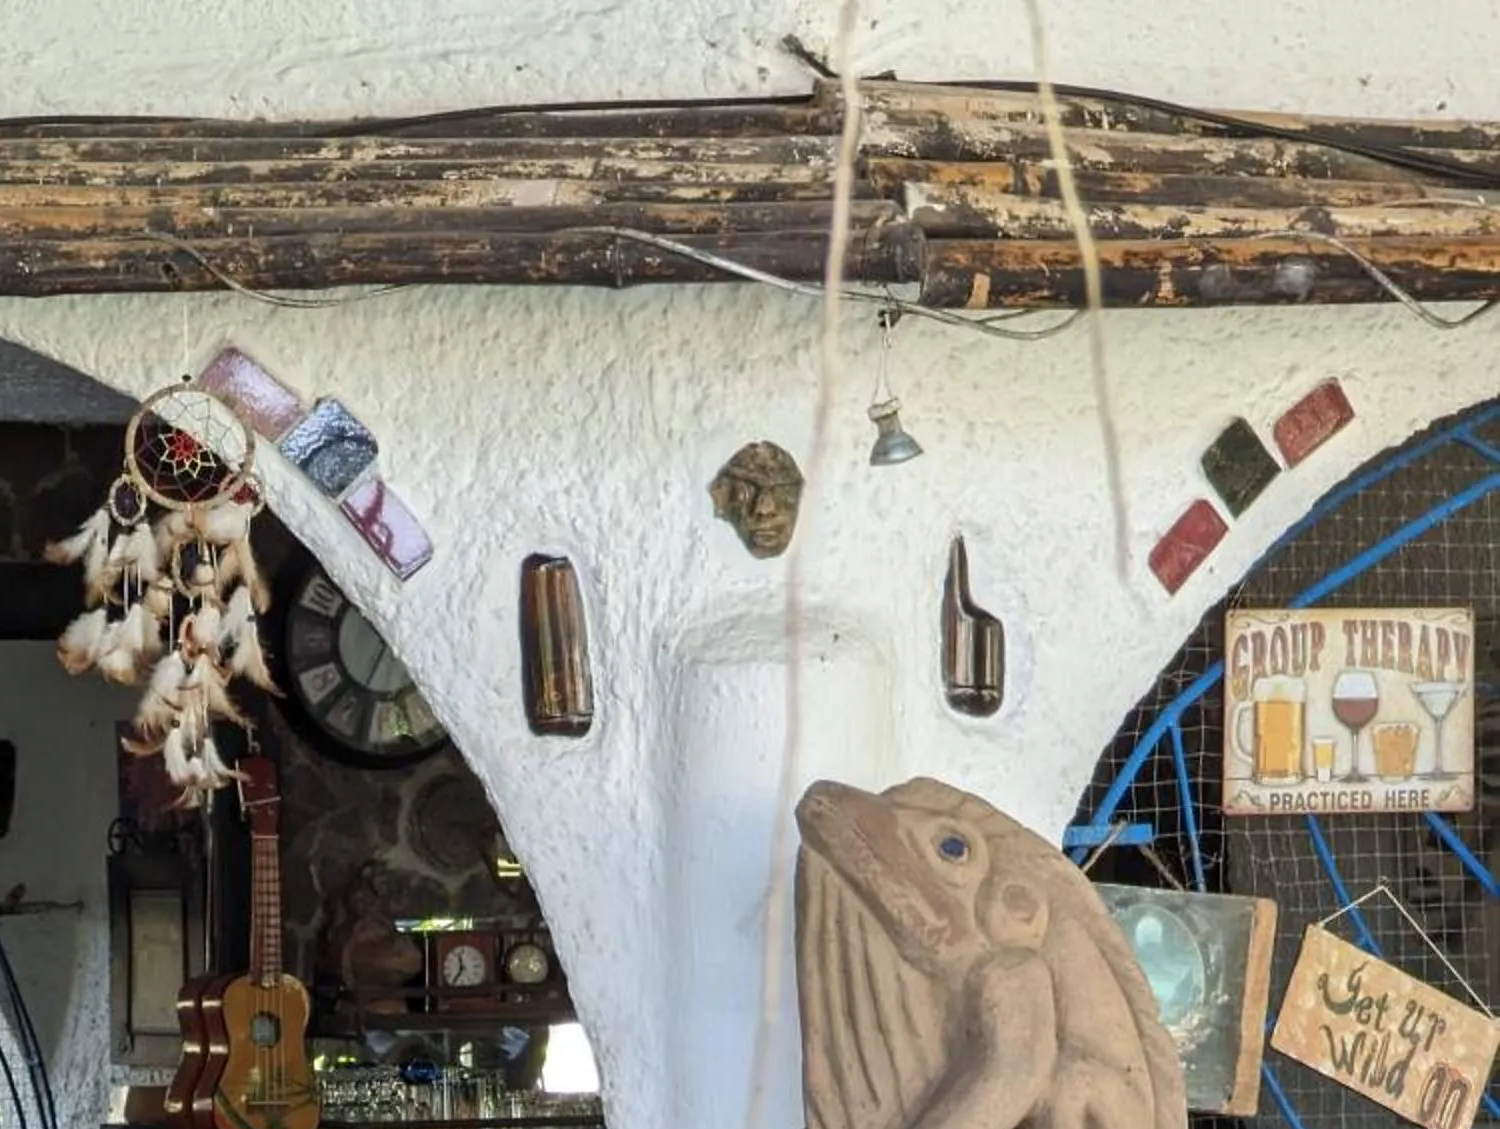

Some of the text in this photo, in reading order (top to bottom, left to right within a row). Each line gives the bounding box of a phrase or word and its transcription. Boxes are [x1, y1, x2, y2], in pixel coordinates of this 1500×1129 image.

[1231, 619, 1472, 700] GROUP THERAPY
[1269, 788, 1431, 812] PRACTICED HERE
[1316, 960, 1392, 1033] Get
[1318, 1023, 1420, 1099] Wild
